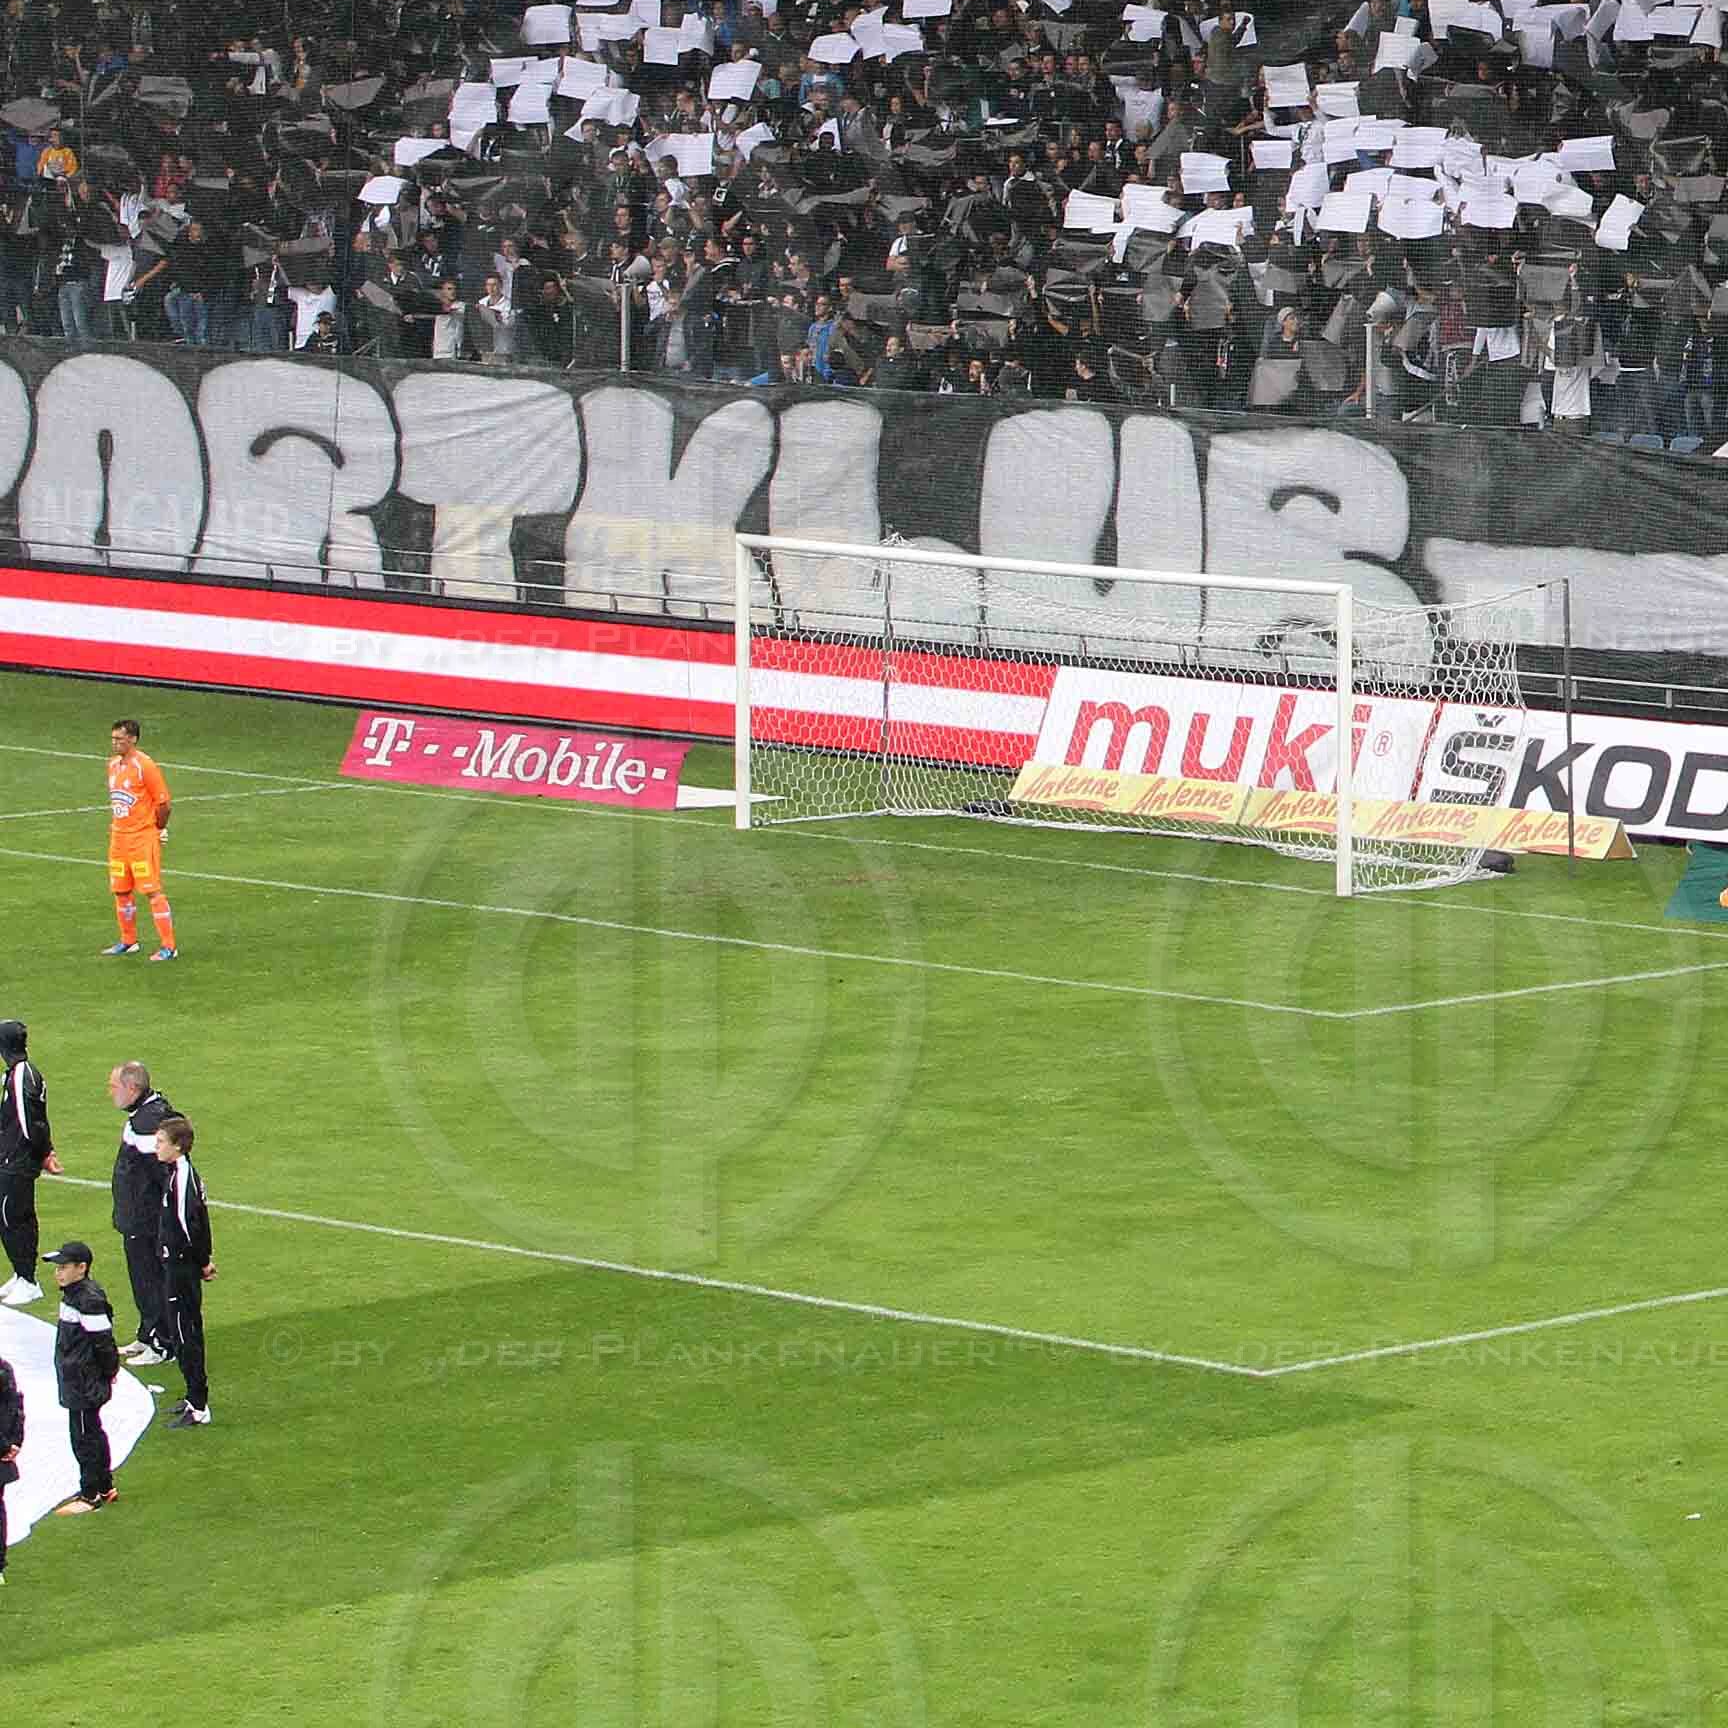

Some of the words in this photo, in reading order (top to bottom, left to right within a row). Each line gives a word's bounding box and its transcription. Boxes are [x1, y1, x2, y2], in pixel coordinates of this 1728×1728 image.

[1063, 692, 1374, 795] muki
[1134, 777, 1234, 815] Antenne
[1493, 808, 1603, 855] Antenne
